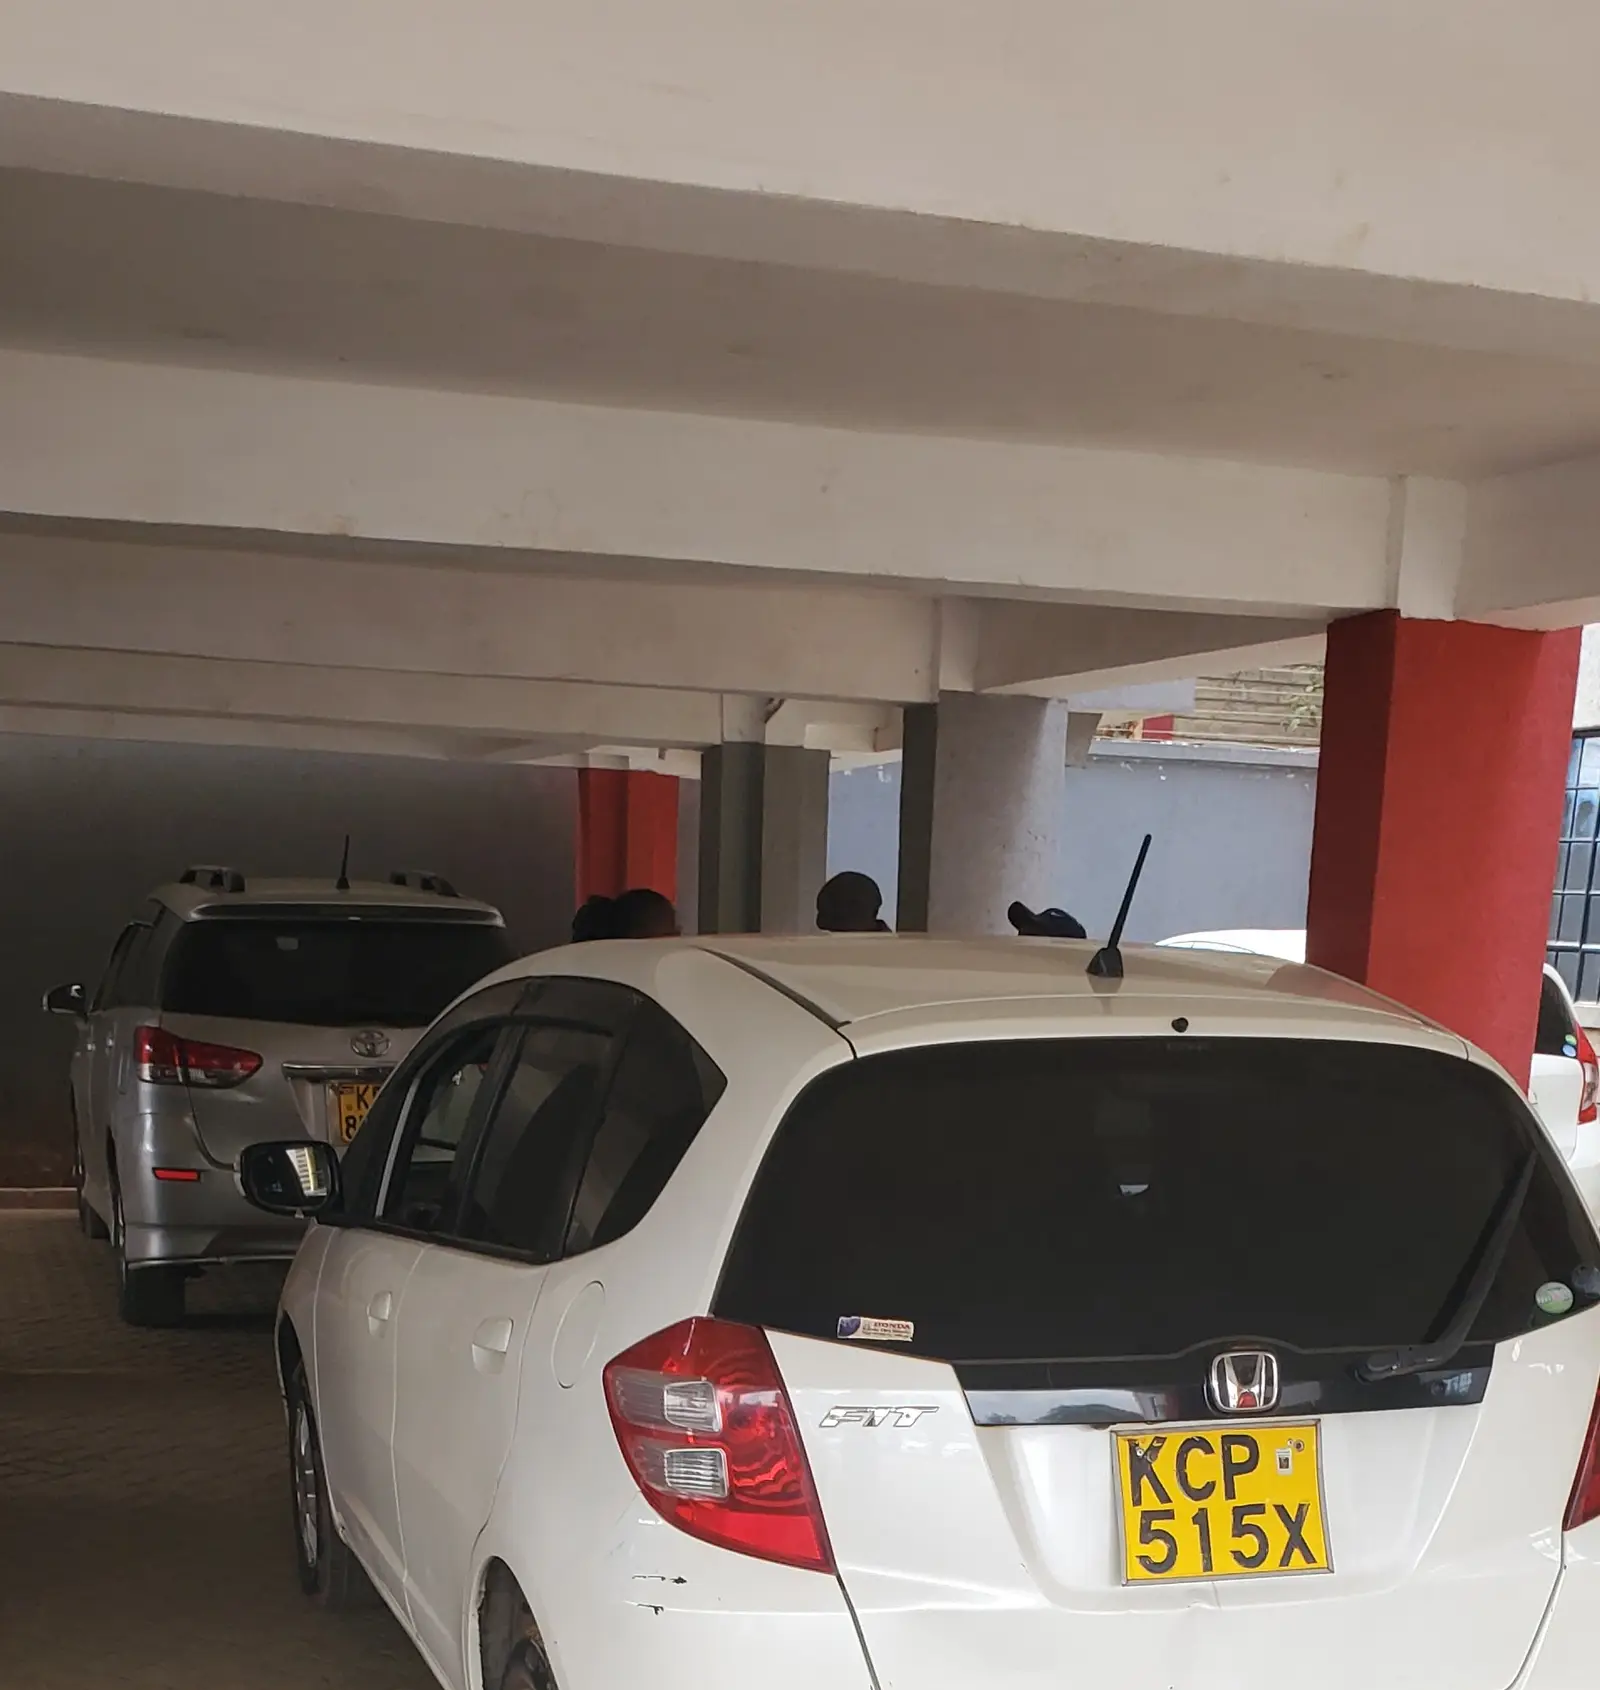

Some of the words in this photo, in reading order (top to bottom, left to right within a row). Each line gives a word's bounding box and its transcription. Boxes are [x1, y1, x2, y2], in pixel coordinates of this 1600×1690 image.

[345, 1115, 364, 1139] 8
[818, 1405, 940, 1428] FIT
[1127, 1434, 1260, 1507] KCP
[1136, 1503, 1317, 1574] 515X
